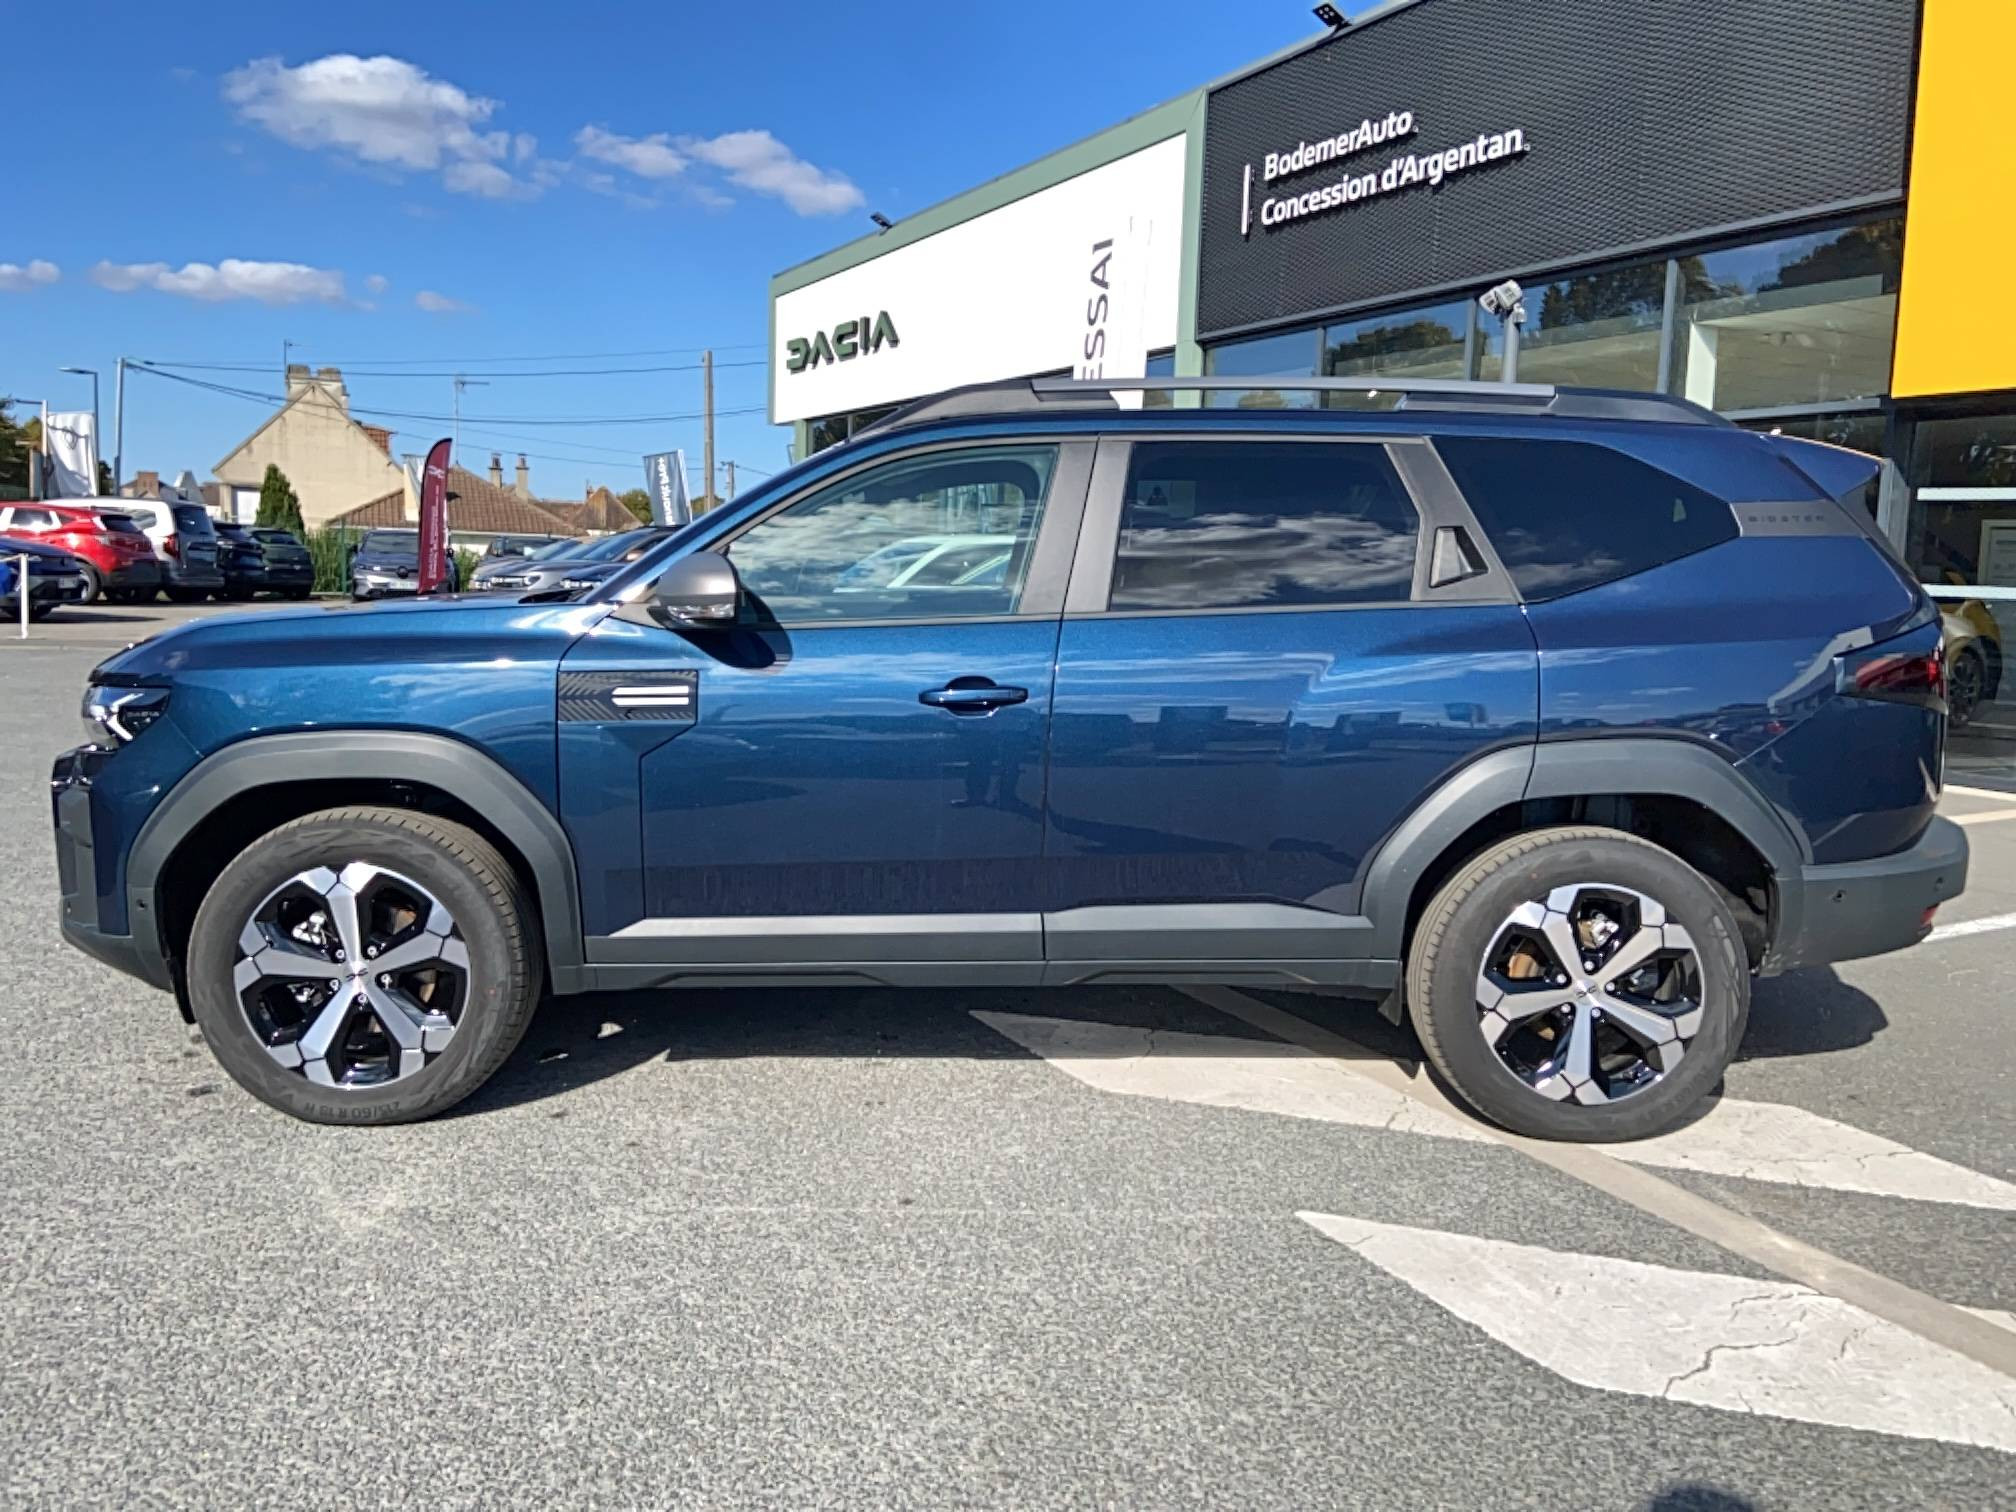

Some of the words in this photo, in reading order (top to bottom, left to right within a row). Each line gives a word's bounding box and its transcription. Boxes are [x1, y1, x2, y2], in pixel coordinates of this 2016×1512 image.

[1261, 173, 1378, 226] Concession
[1380, 128, 1524, 192] d'Argentan
[1264, 111, 1413, 181] BodemerAuto
[786, 310, 899, 374] DACIA
